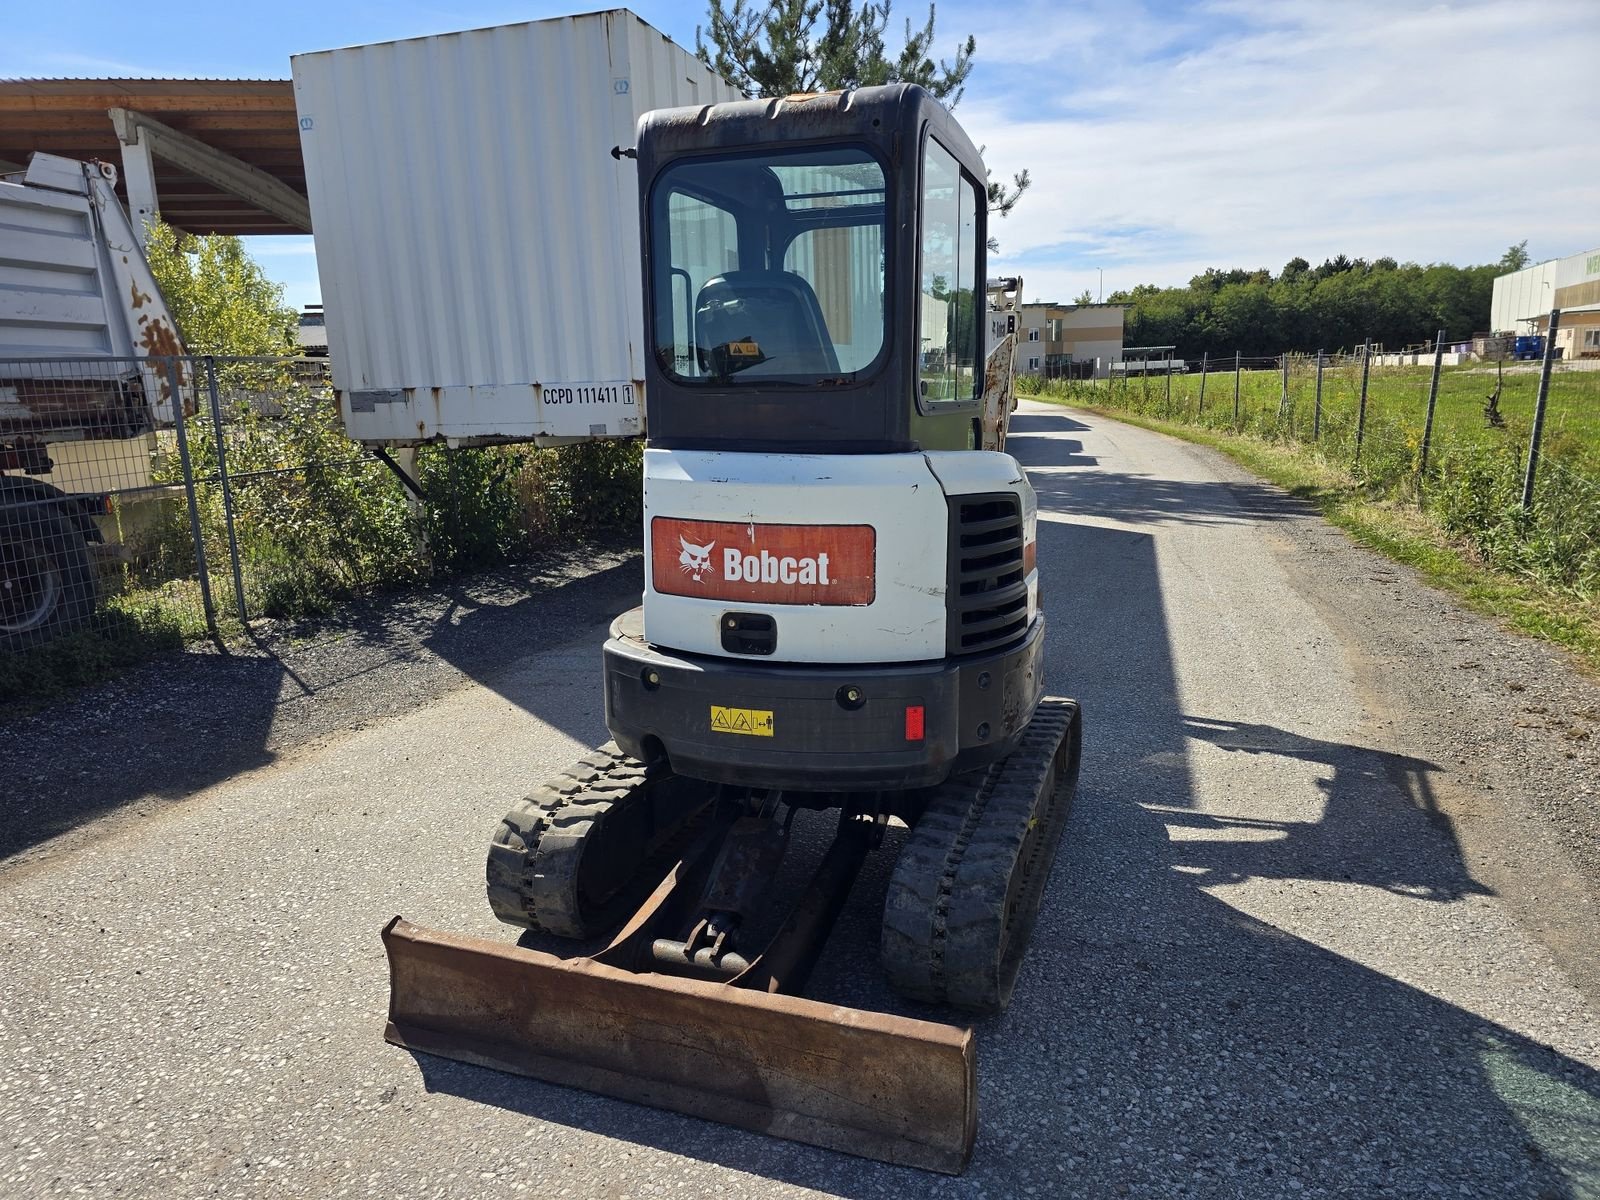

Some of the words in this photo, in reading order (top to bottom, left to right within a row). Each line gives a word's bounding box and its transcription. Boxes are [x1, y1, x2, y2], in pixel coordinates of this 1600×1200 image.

[543, 388, 573, 405] CCPD
[576, 386, 618, 404] 111411
[623, 385, 633, 404] 1
[723, 547, 830, 586] Bobcat
